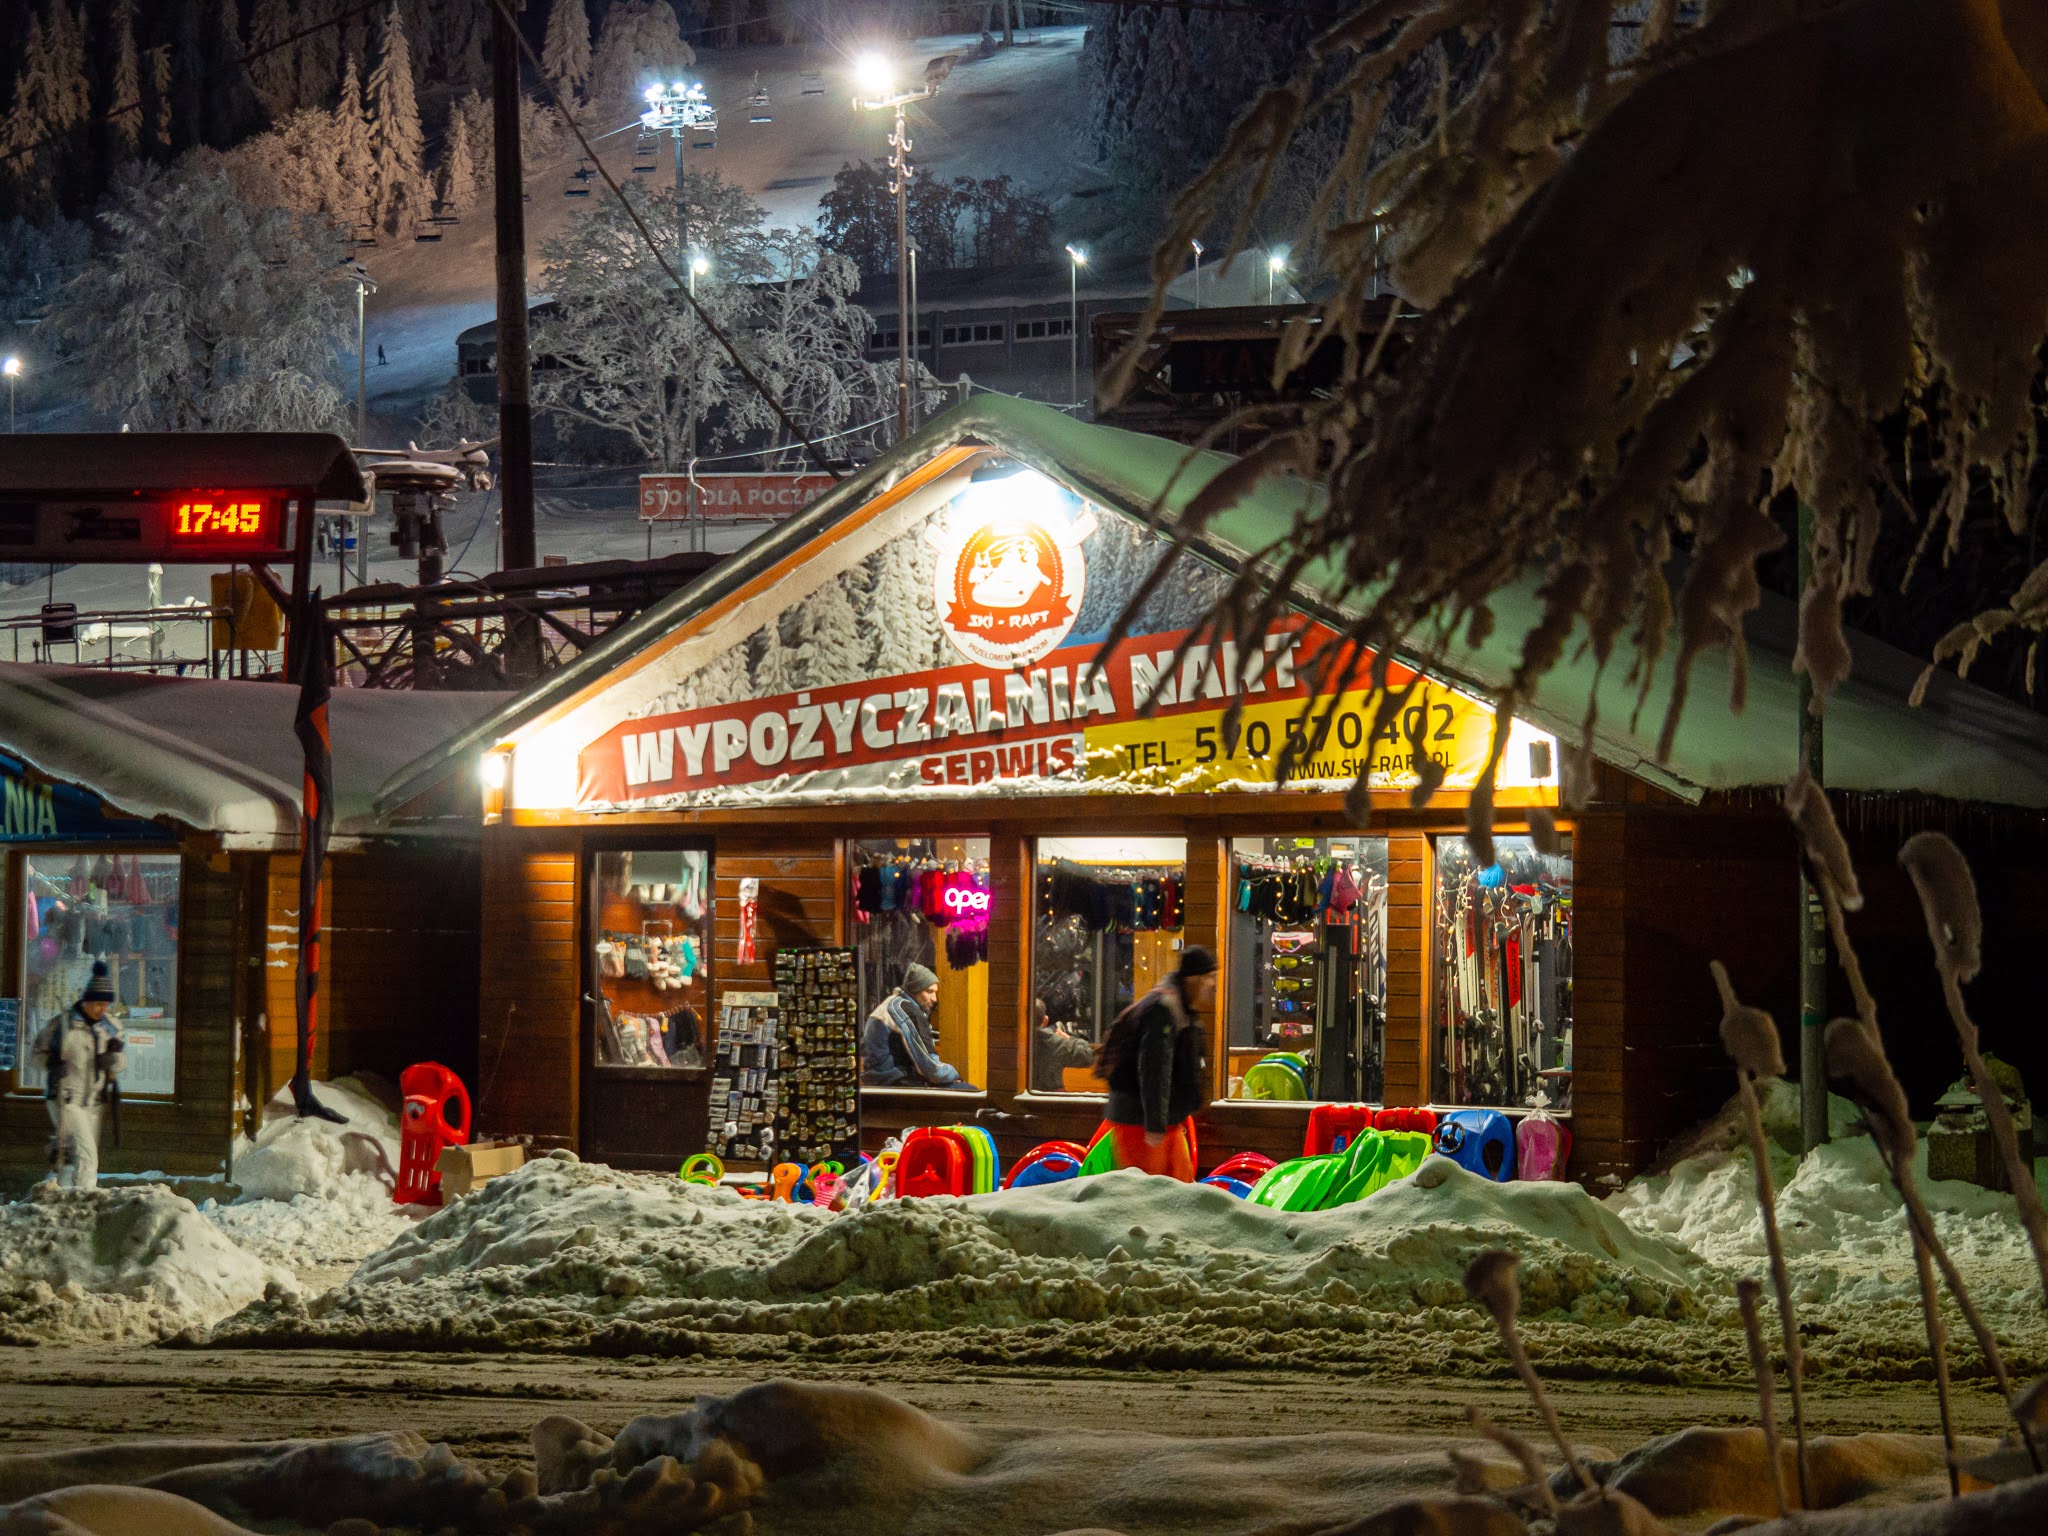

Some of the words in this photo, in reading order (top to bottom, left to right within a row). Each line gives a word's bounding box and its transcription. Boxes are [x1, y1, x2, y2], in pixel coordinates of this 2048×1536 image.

[643, 488, 696, 506] STO
[702, 488, 742, 505] DLA
[178, 502, 261, 534] 17:45
[967, 612, 994, 629] SKI
[1009, 610, 1049, 629] RAFT
[622, 663, 1116, 786] WYPOŻYCZALNIA
[1129, 632, 1301, 709] NART
[1125, 741, 1181, 771] TEL.
[1375, 703, 1455, 744] 402
[920, 739, 1076, 786] SERWIS
[1283, 751, 1454, 779] WW.SK-RAFPL
[0, 776, 58, 834] NIA
